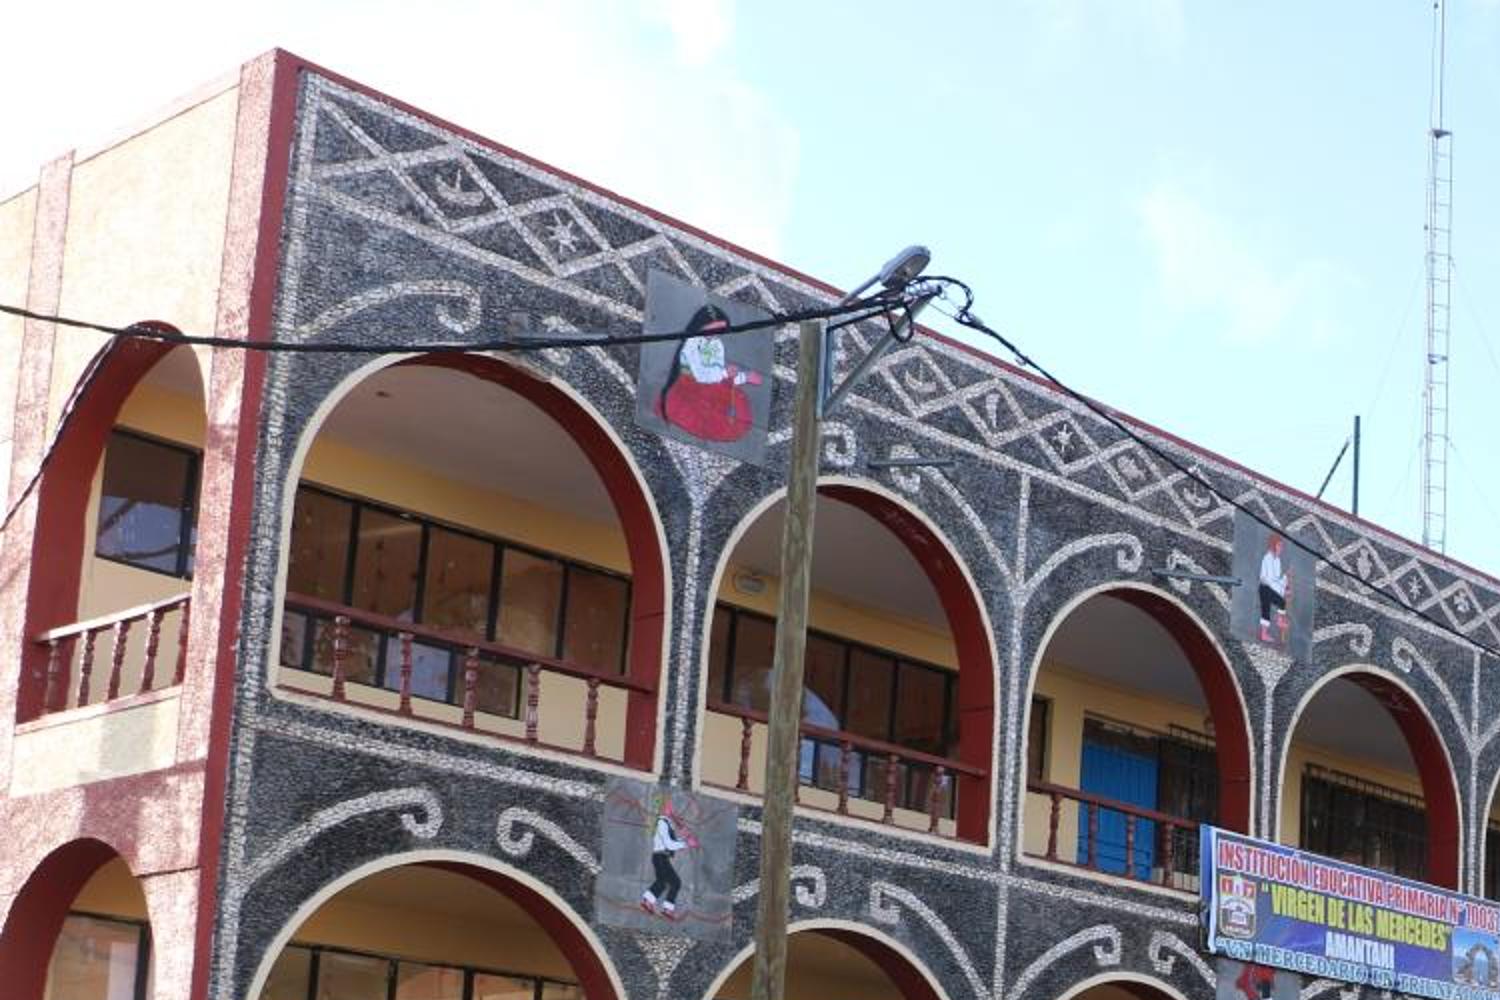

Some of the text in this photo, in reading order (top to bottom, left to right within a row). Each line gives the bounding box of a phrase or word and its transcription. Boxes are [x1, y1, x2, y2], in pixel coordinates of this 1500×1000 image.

[1312, 862, 1385, 907] EDUCATIVA
[1386, 881, 1447, 921] PRIMARIA
[1327, 897, 1345, 929] DE
[1347, 901, 1373, 935] LAS
